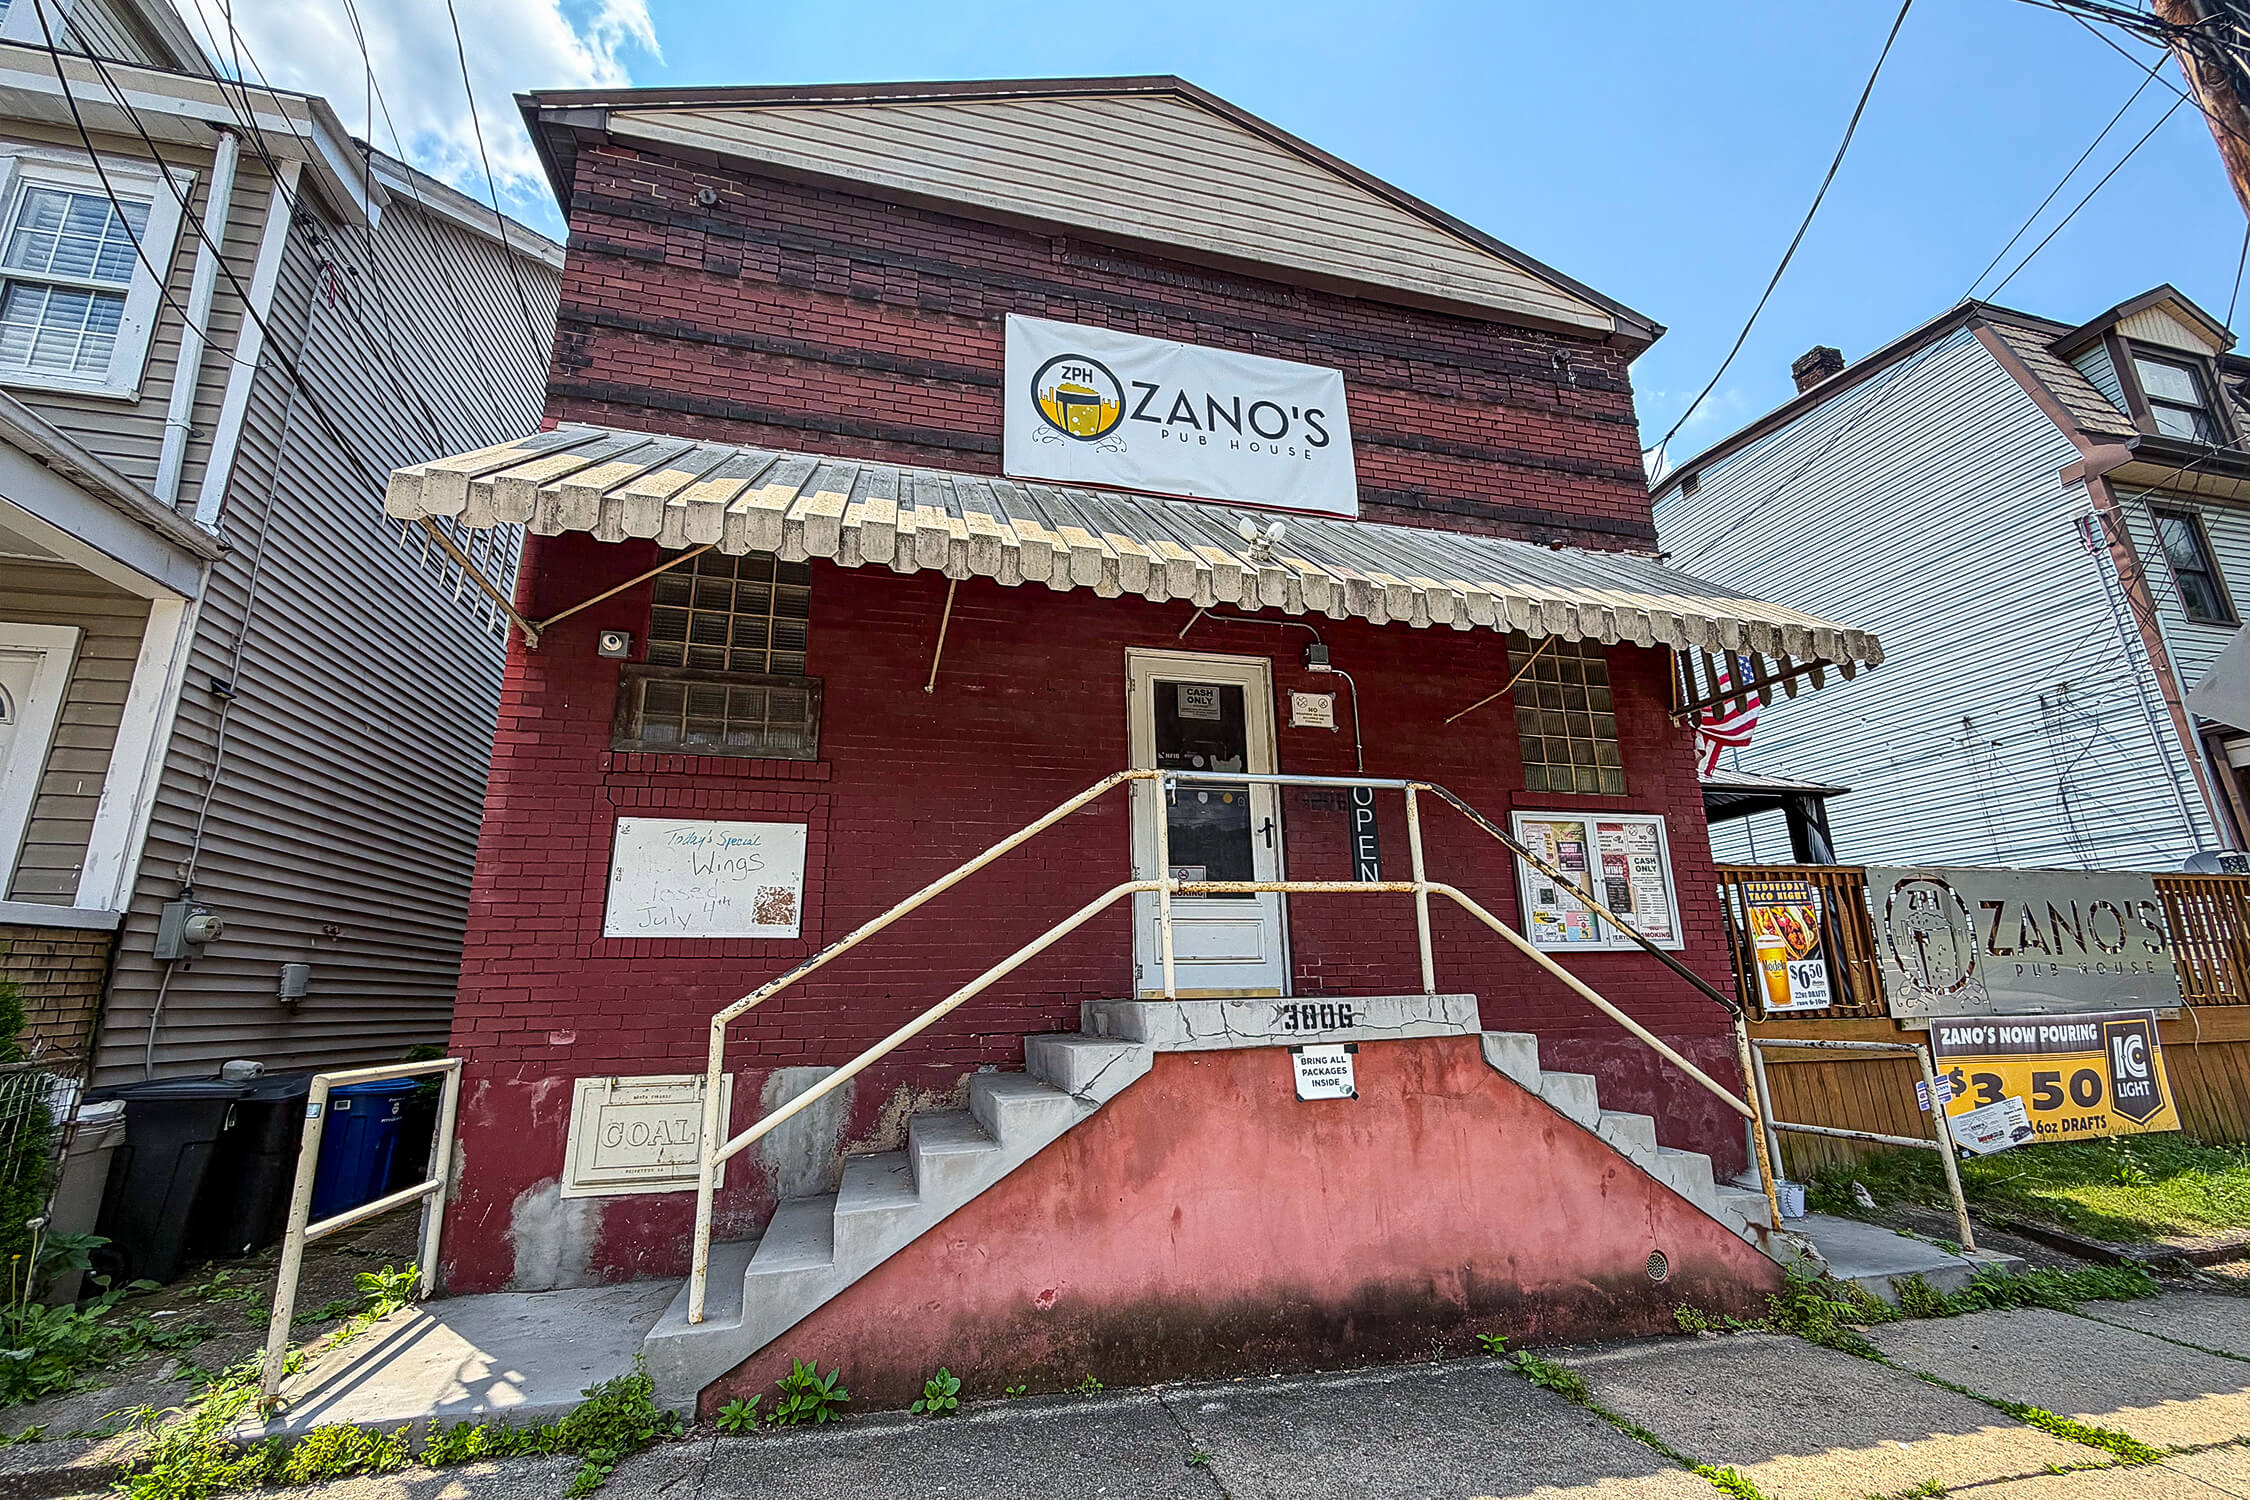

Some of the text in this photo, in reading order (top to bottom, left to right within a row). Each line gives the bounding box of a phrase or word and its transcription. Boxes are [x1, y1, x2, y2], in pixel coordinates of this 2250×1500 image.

[1061, 365, 1093, 384] ZPH
[1130, 380, 1330, 448] ZANO'S
[1161, 429, 1312, 460] PUB HOUSE
[1186, 688, 1214, 697] CASH
[1187, 696, 1213, 705] ONLY
[663, 826, 763, 850] Today's Special
[1352, 786, 1379, 882] OPEN
[1633, 857, 1657, 865] CASH
[1635, 865, 1657, 873] ONLY
[1746, 882, 1805, 892] WEDNESDAY
[1748, 891, 1808, 901] TACO NIGHT
[1907, 890, 1941, 911] ZPH
[636, 906, 692, 931] July
[1978, 899, 2167, 957] ZANO'S
[2015, 961, 2155, 978] PUB HOUSE
[1939, 1023, 2098, 1046] ZANO'S NOW POURING
[1301, 1055, 1346, 1066] BRING ALL
[2112, 1033, 2148, 1080] IC
[1302, 1066, 1348, 1077] PACKAGES
[1311, 1078, 1340, 1087] INSIDE
[2116, 1080, 2150, 1098] LIGHT
[2061, 1114, 2107, 1133] DRAFTS
[601, 1119, 696, 1148] COAL
